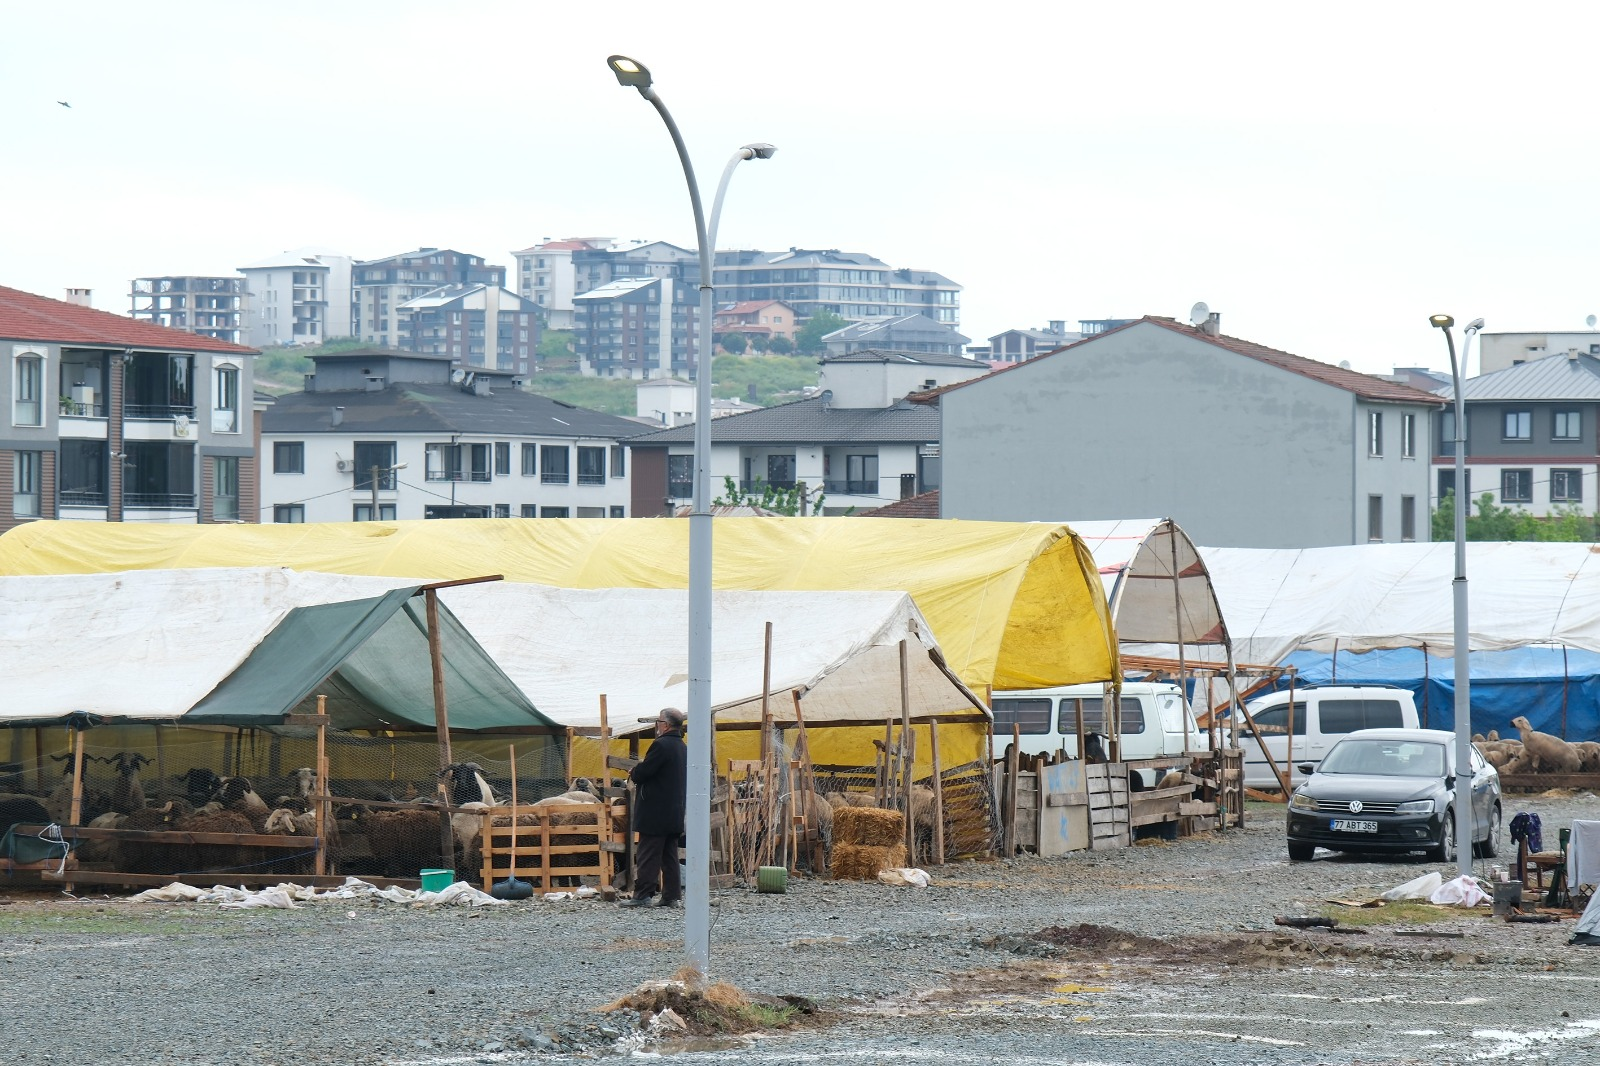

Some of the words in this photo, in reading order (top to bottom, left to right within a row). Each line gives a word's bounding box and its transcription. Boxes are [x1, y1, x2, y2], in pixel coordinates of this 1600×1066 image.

[1334, 820, 1344, 828] 77
[1346, 821, 1361, 829] ABT
[1362, 822, 1377, 830] 365
